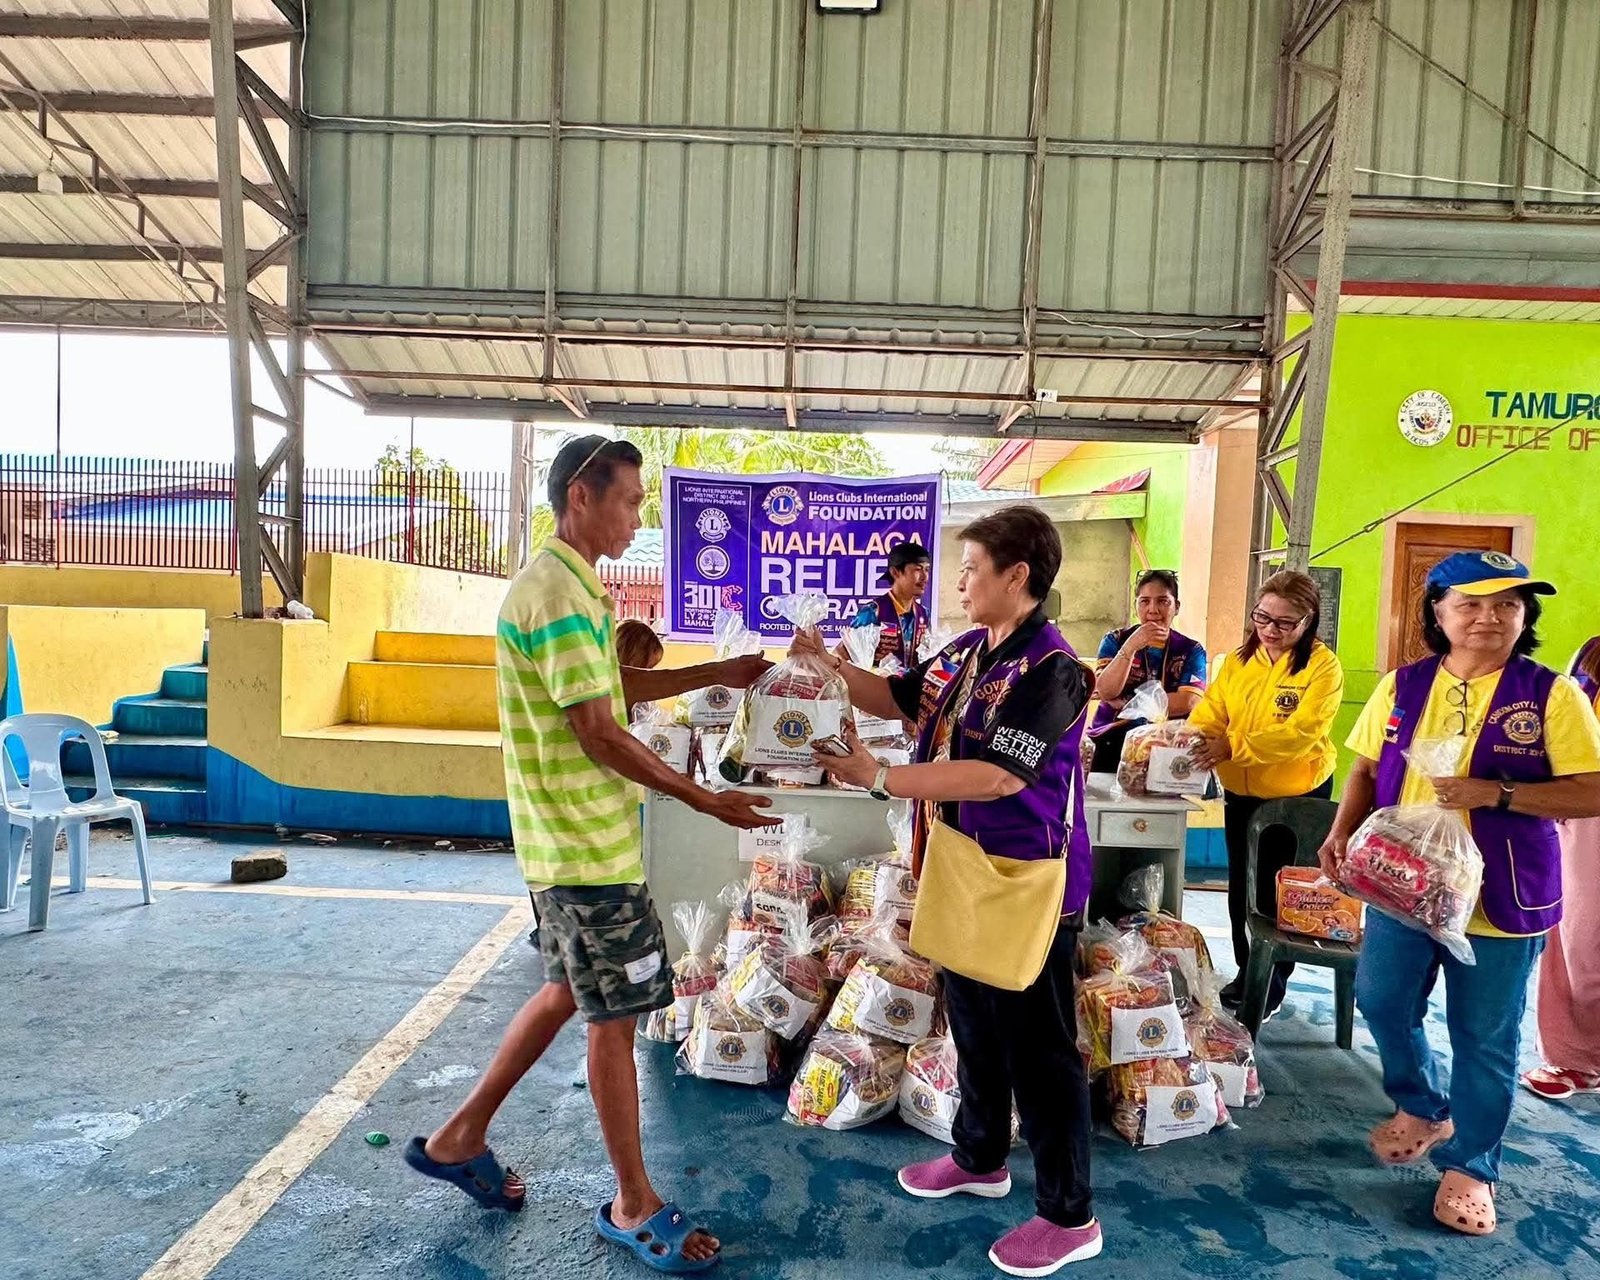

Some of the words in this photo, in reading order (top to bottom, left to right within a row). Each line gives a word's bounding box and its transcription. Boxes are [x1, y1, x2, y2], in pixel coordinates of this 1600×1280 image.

[1456, 424, 1551, 451] OFFICE
[771, 486, 796, 497] LIONS
[808, 491, 835, 502] Lions
[836, 491, 862, 503] Clubs
[863, 491, 928, 503] International
[808, 505, 928, 521] FOUNDATION
[760, 557, 893, 597] RELIE
[684, 620, 716, 628] MAHALA
[759, 623, 791, 632] ROOTED
[1512, 700, 1530, 710] CITY
[997, 726, 1016, 738] WE
[1015, 730, 1048, 752] SERVE
